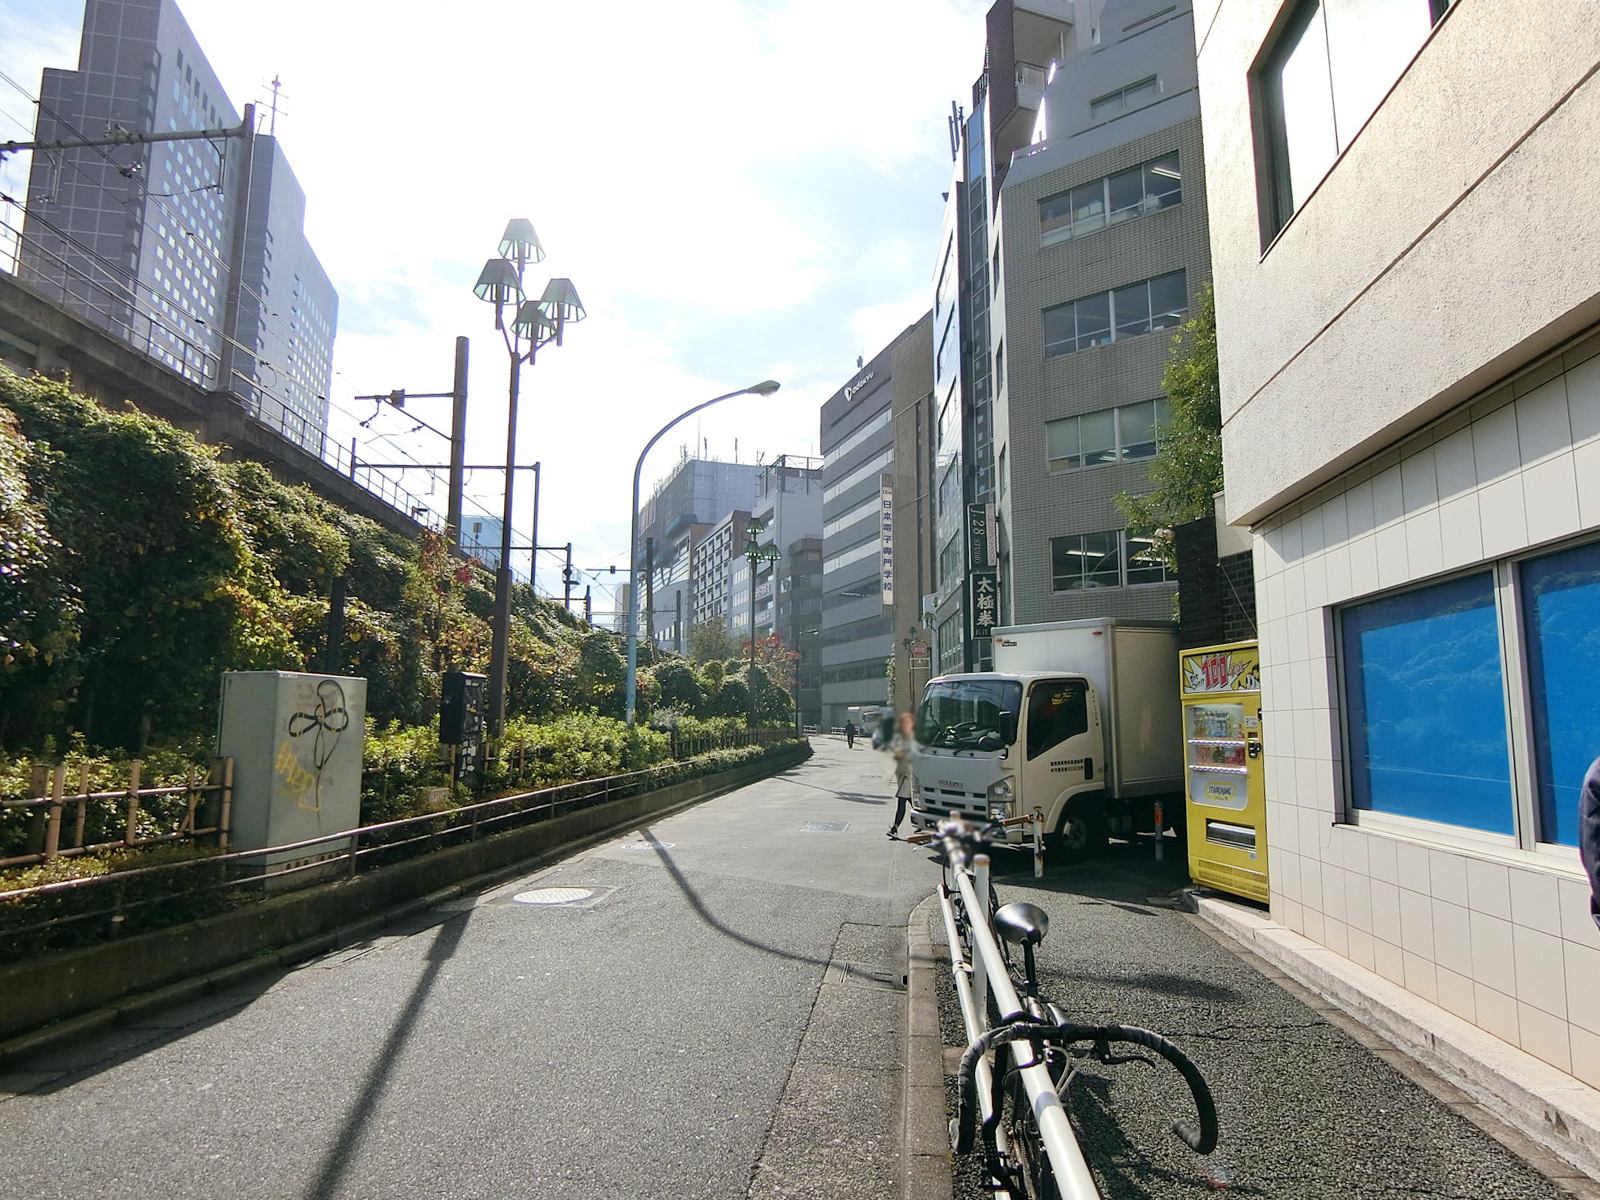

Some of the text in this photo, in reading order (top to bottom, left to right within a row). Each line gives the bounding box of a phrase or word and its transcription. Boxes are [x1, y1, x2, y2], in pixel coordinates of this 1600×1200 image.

[882, 500, 893, 591] 日本電子専門学校
[970, 508, 985, 535] J.28
[976, 576, 996, 627] 太極拳
